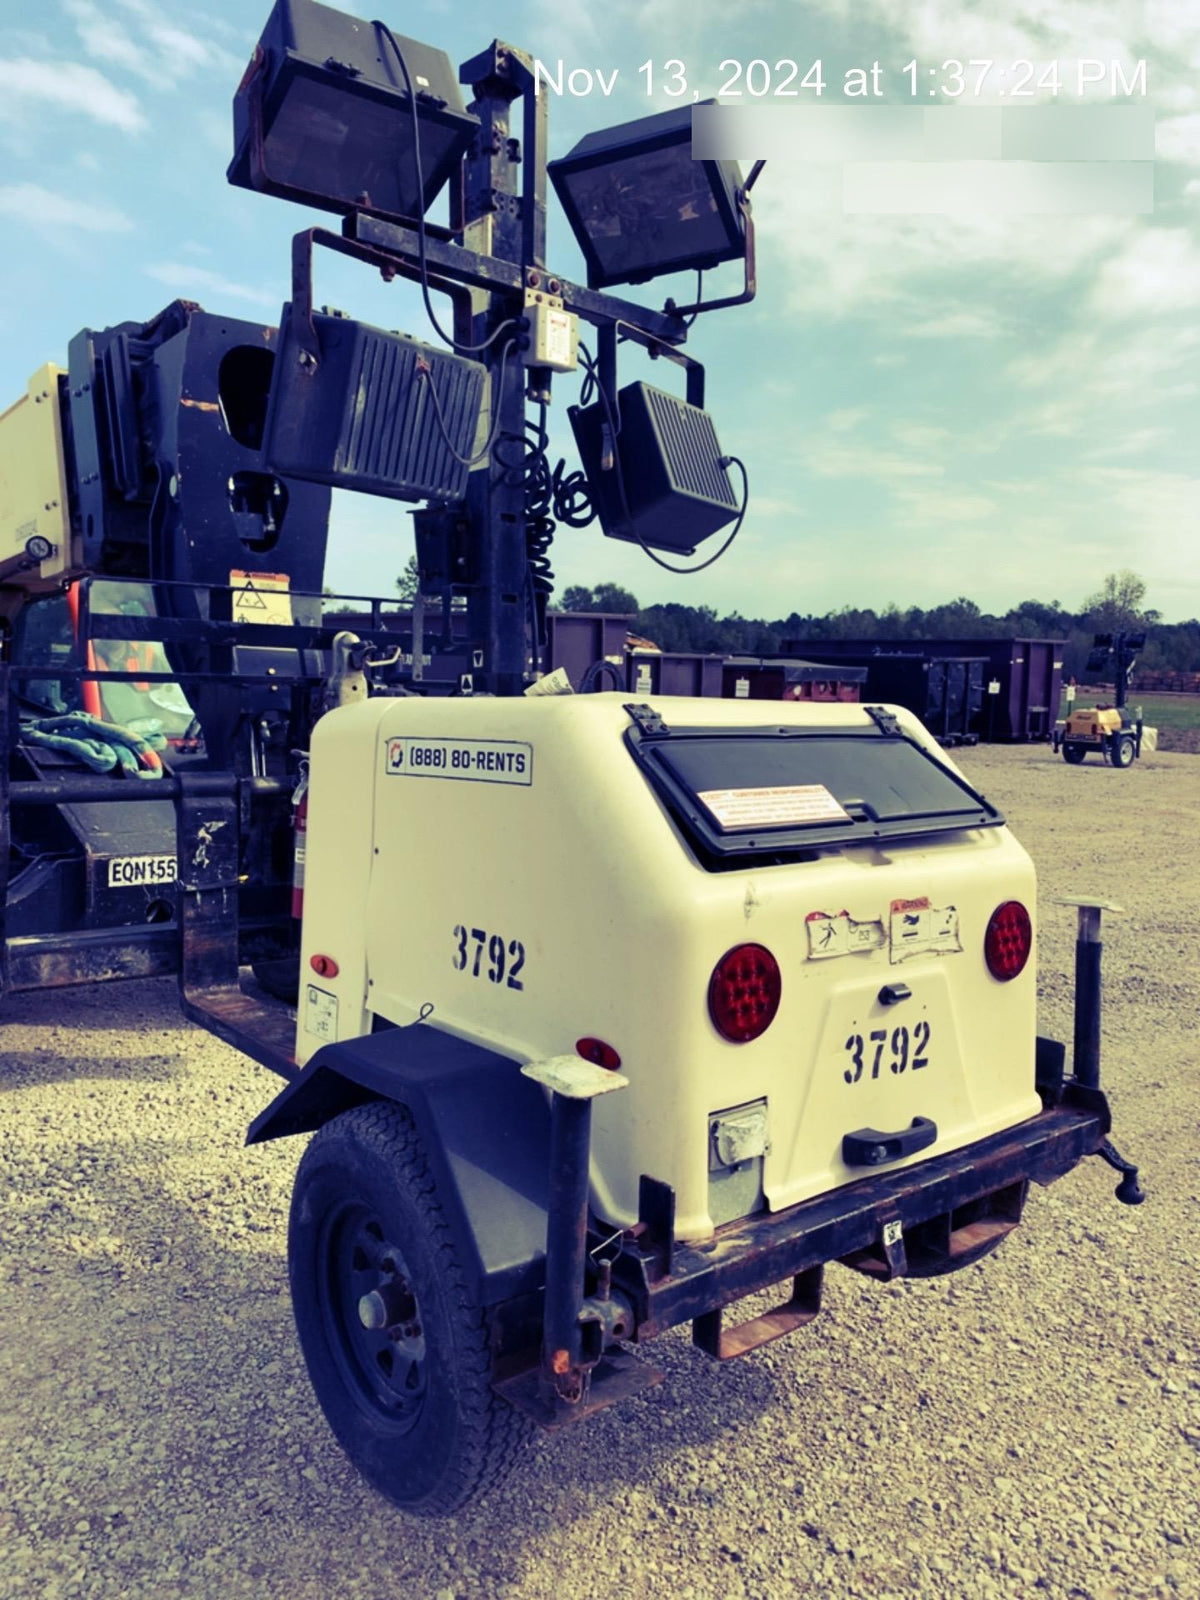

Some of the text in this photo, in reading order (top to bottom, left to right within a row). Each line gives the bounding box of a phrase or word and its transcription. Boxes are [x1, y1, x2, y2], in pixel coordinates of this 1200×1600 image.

[410, 746, 525, 773] (888) 80-RENTS
[452, 924, 525, 992] 3792
[844, 1021, 930, 1084] 3792
